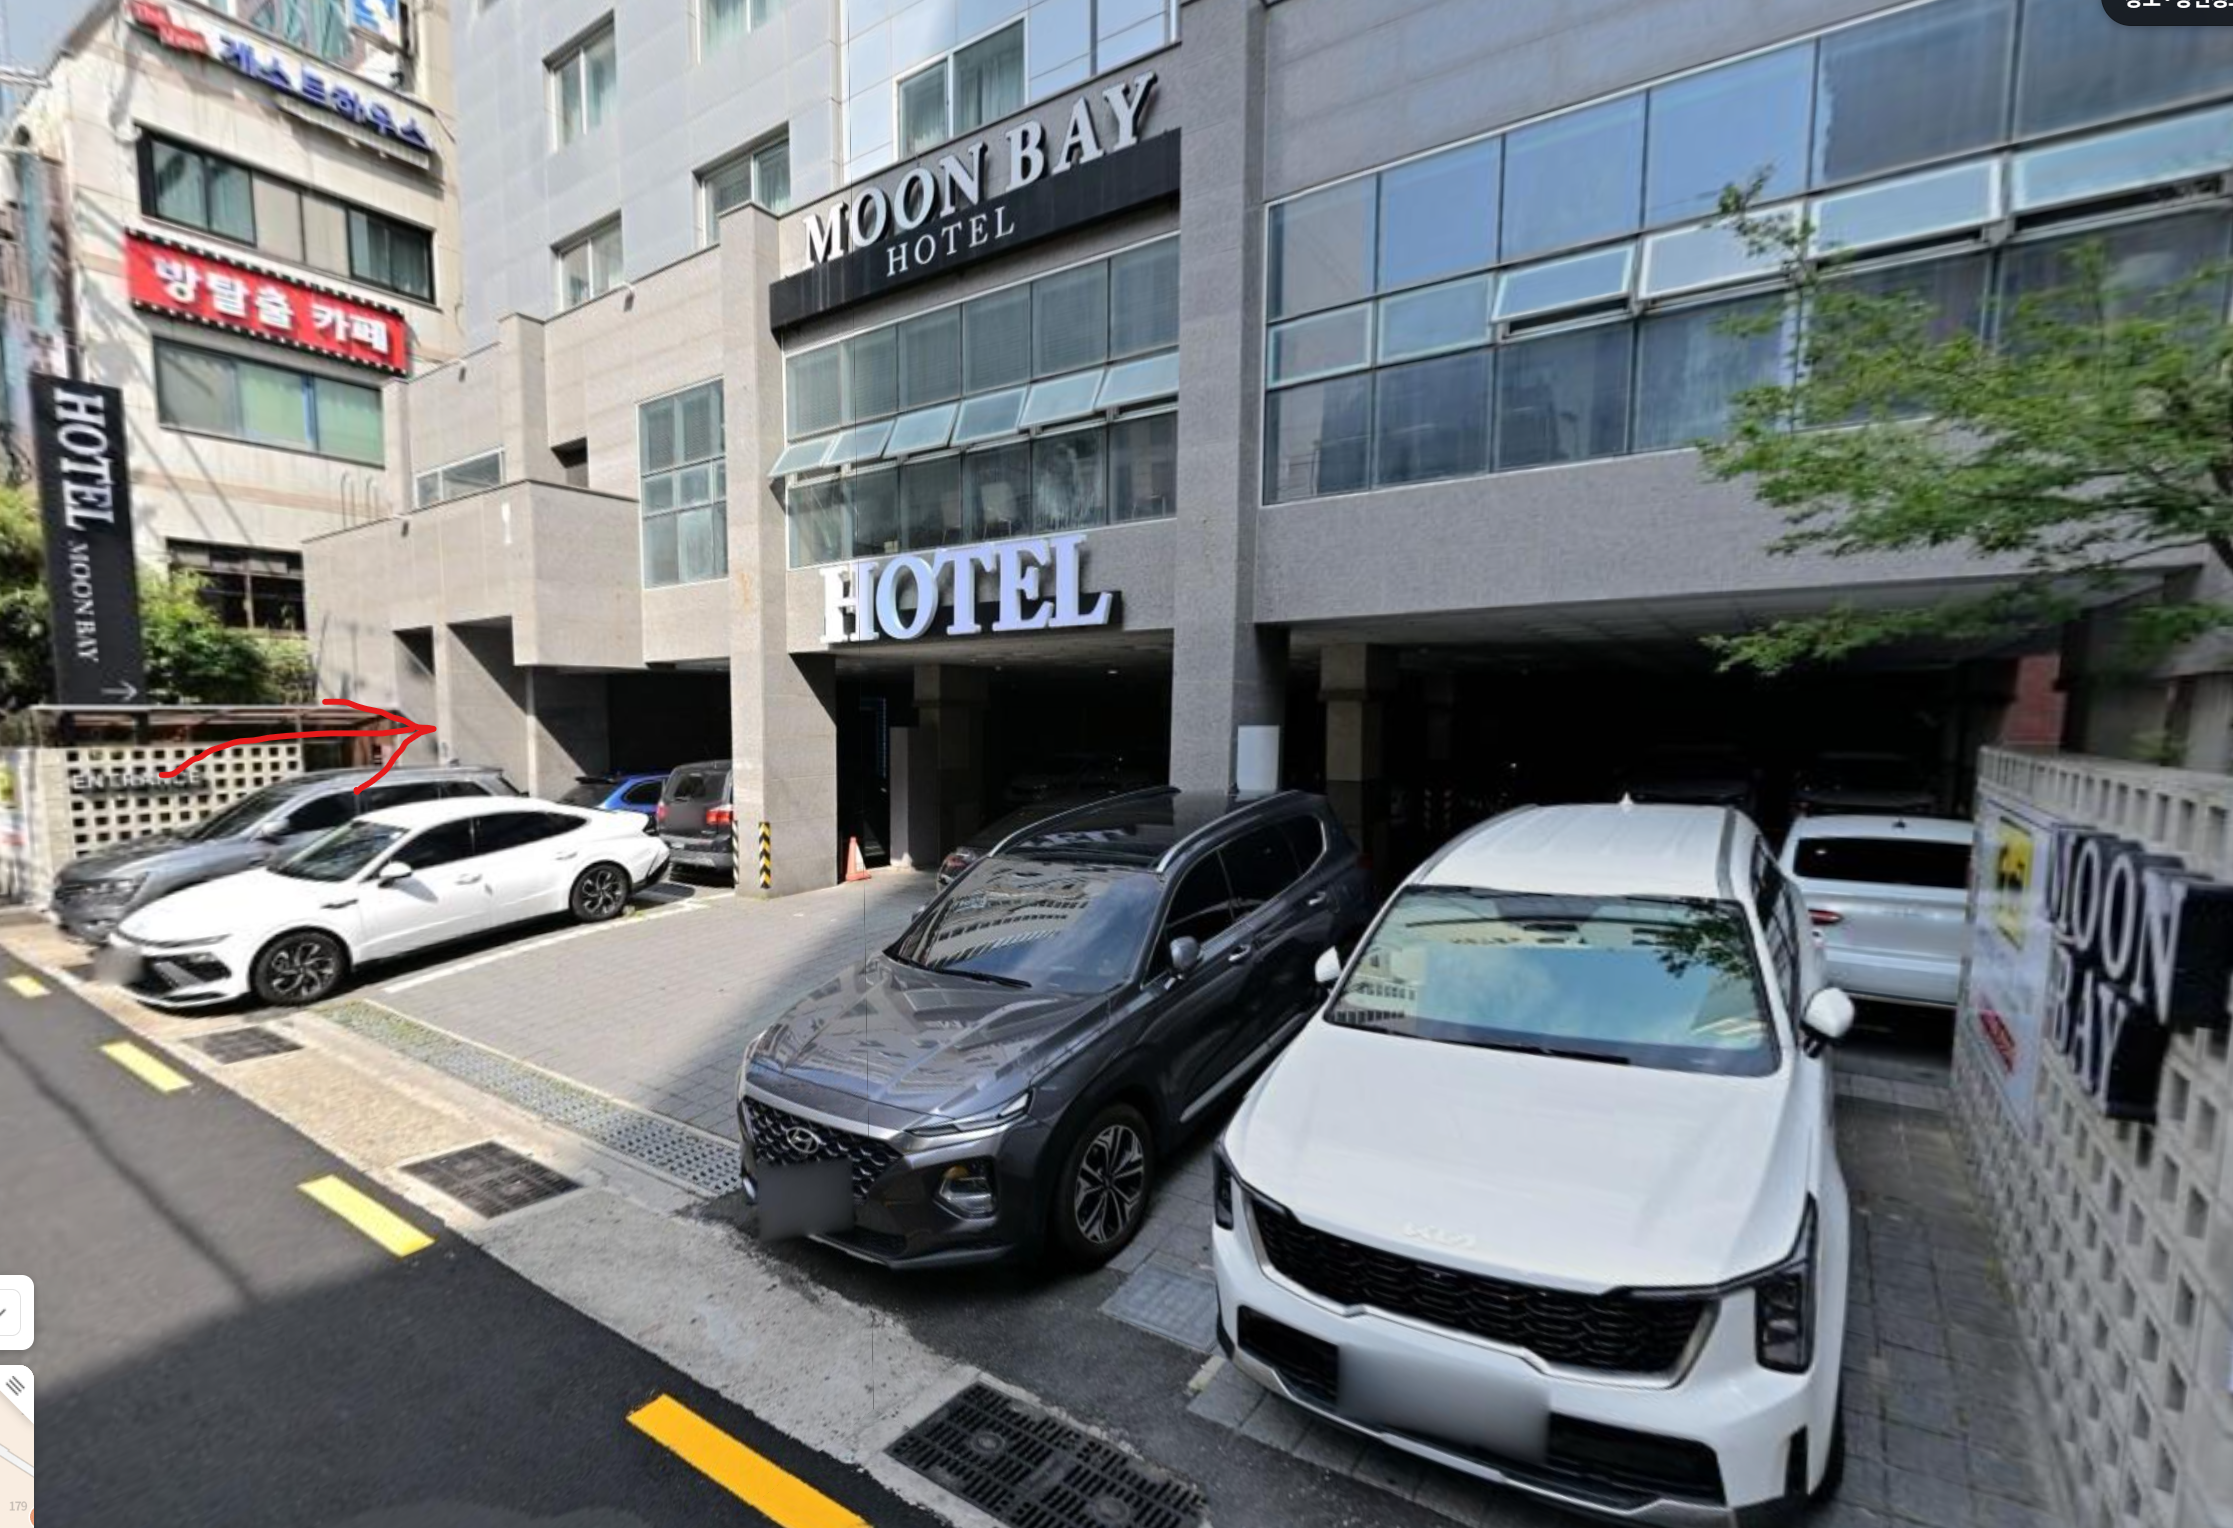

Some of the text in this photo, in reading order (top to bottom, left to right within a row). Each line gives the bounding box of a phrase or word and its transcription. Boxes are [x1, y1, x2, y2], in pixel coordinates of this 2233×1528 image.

[218, 33, 429, 149] 게스트하우스
[801, 71, 1158, 267] MOON BAY
[886, 206, 1015, 277] HOTEL
[310, 302, 390, 353] 카페
[53, 387, 115, 531] HOTEL
[67, 540, 99, 662] MOON BAY
[820, 534, 1112, 645] HOTEL
